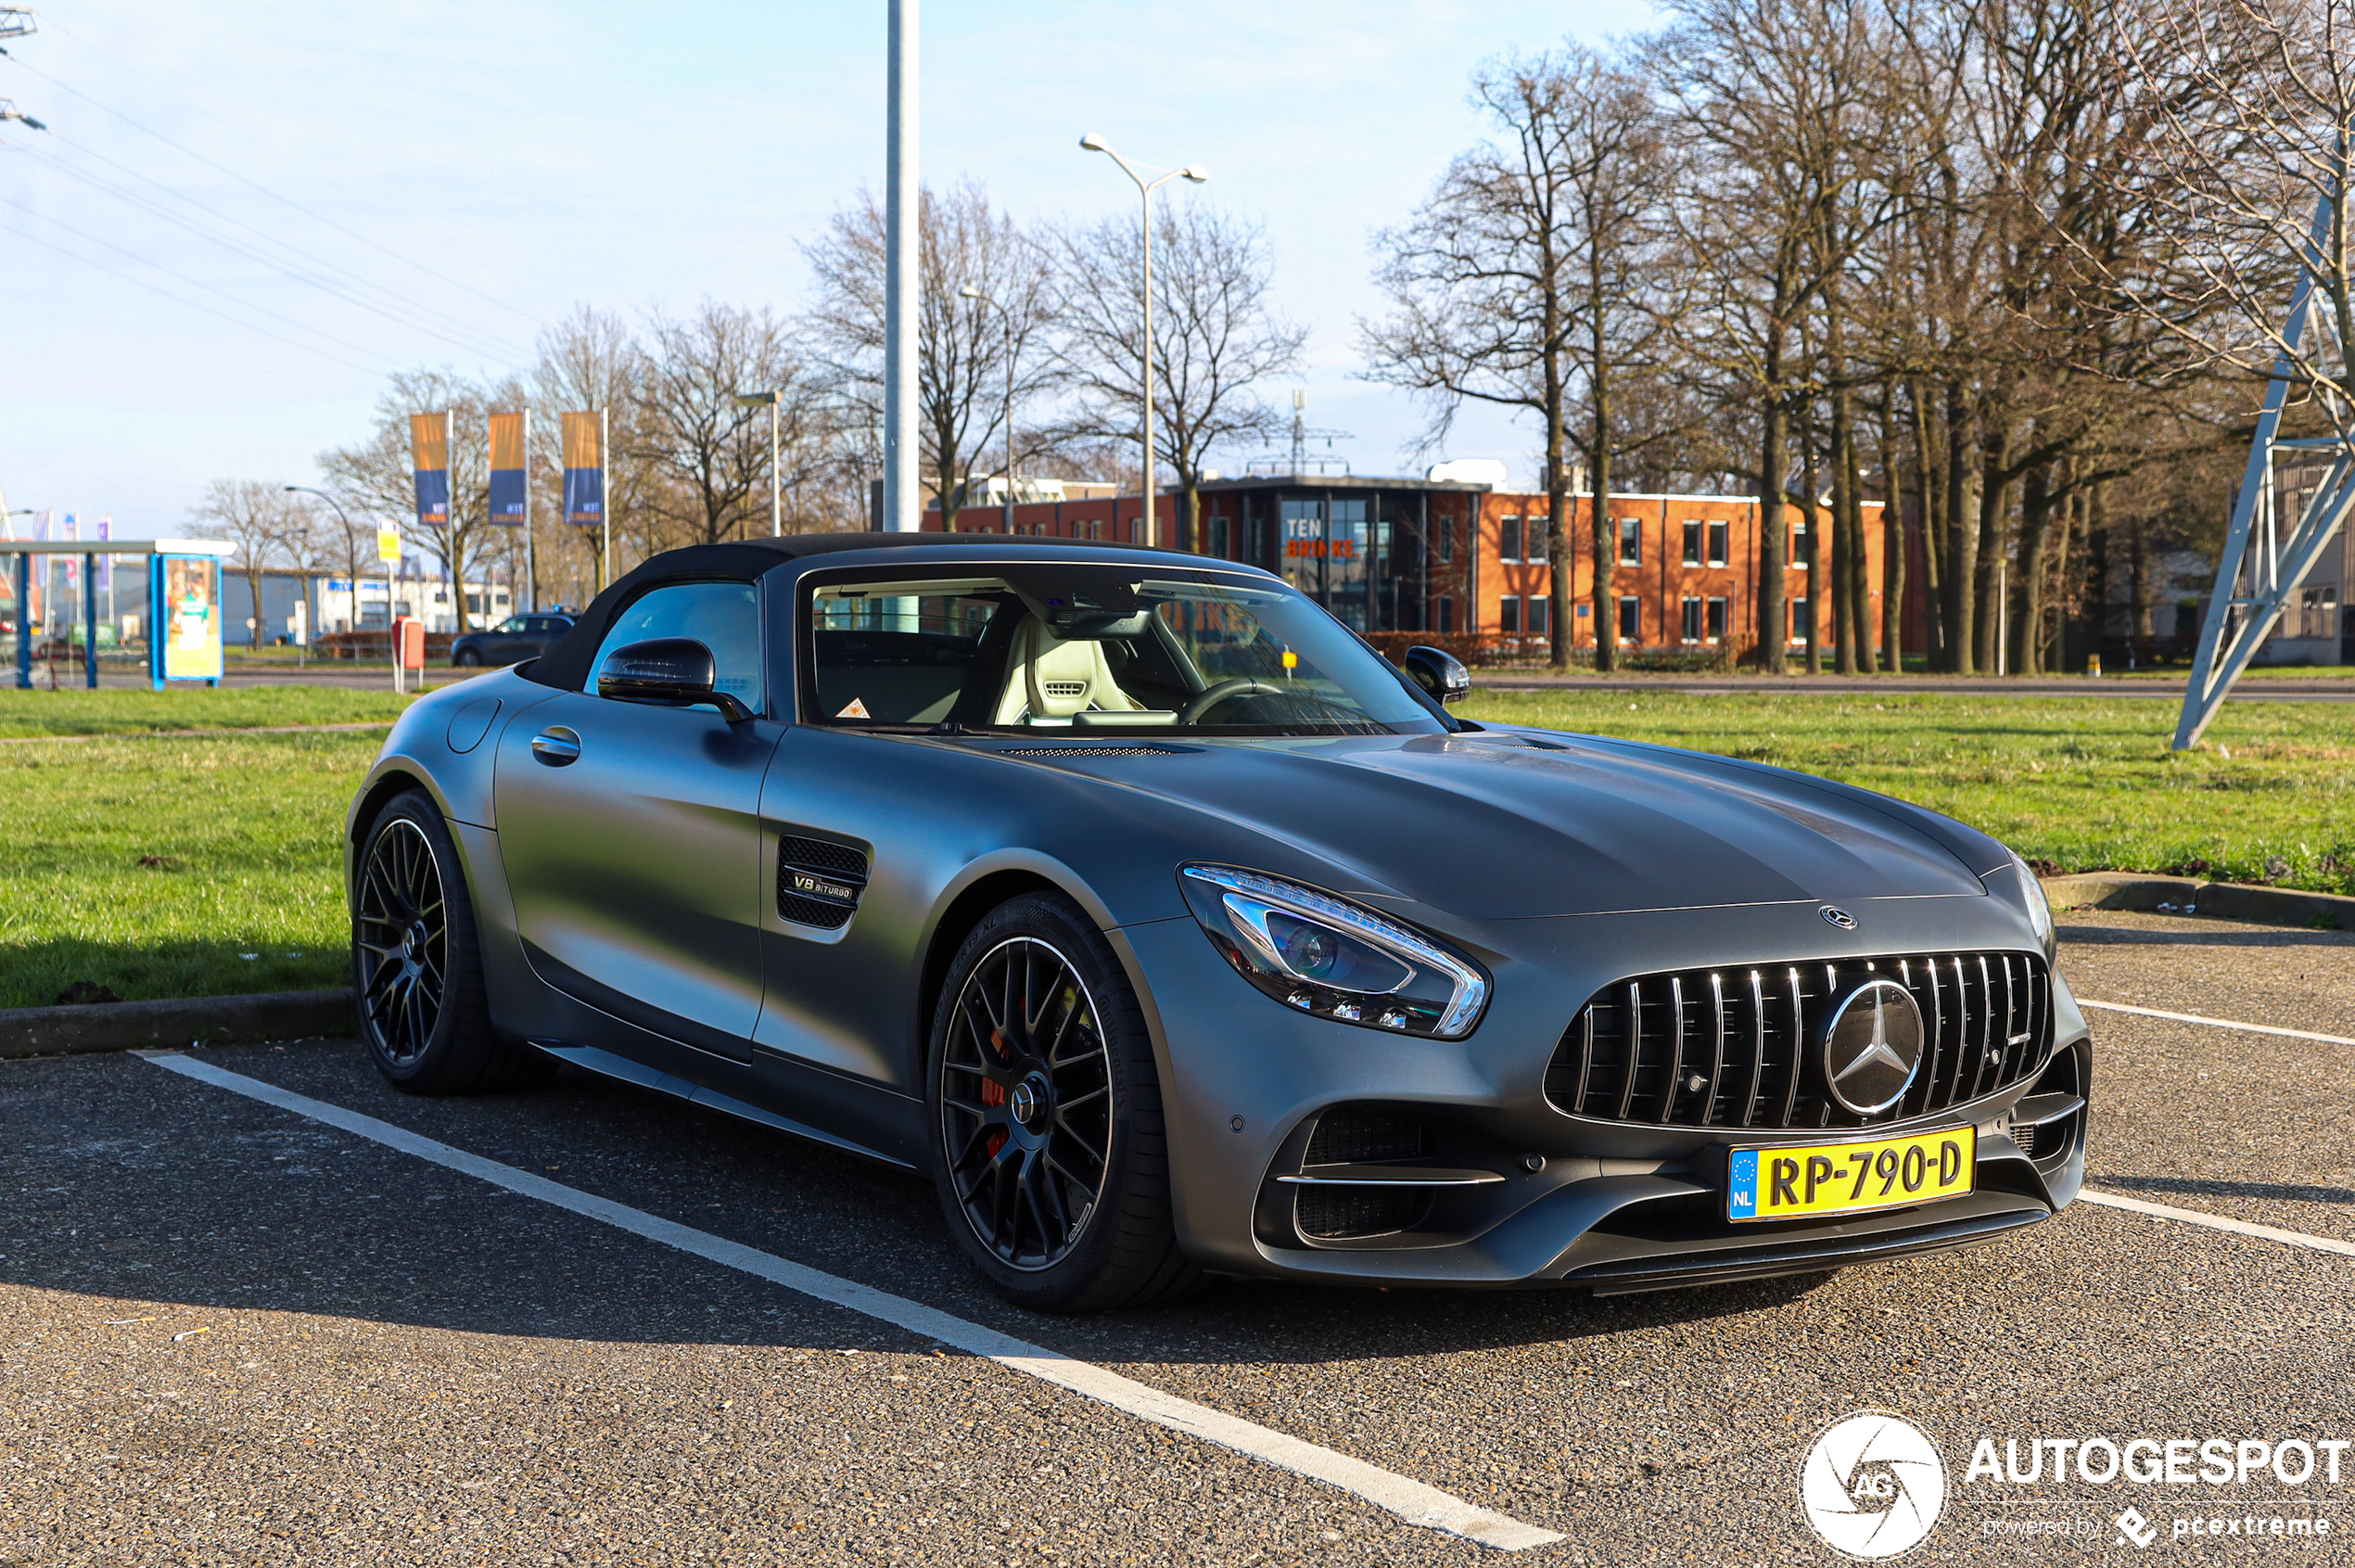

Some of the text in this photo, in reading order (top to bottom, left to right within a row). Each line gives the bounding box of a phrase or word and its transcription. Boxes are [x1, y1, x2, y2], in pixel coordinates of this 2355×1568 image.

[1287, 518, 1321, 537] TEN
[794, 876, 814, 890] V8
[815, 884, 850, 898] BITURBO
[1770, 1140, 1962, 1207] RP-790-D
[1733, 1191, 1752, 1207] NL
